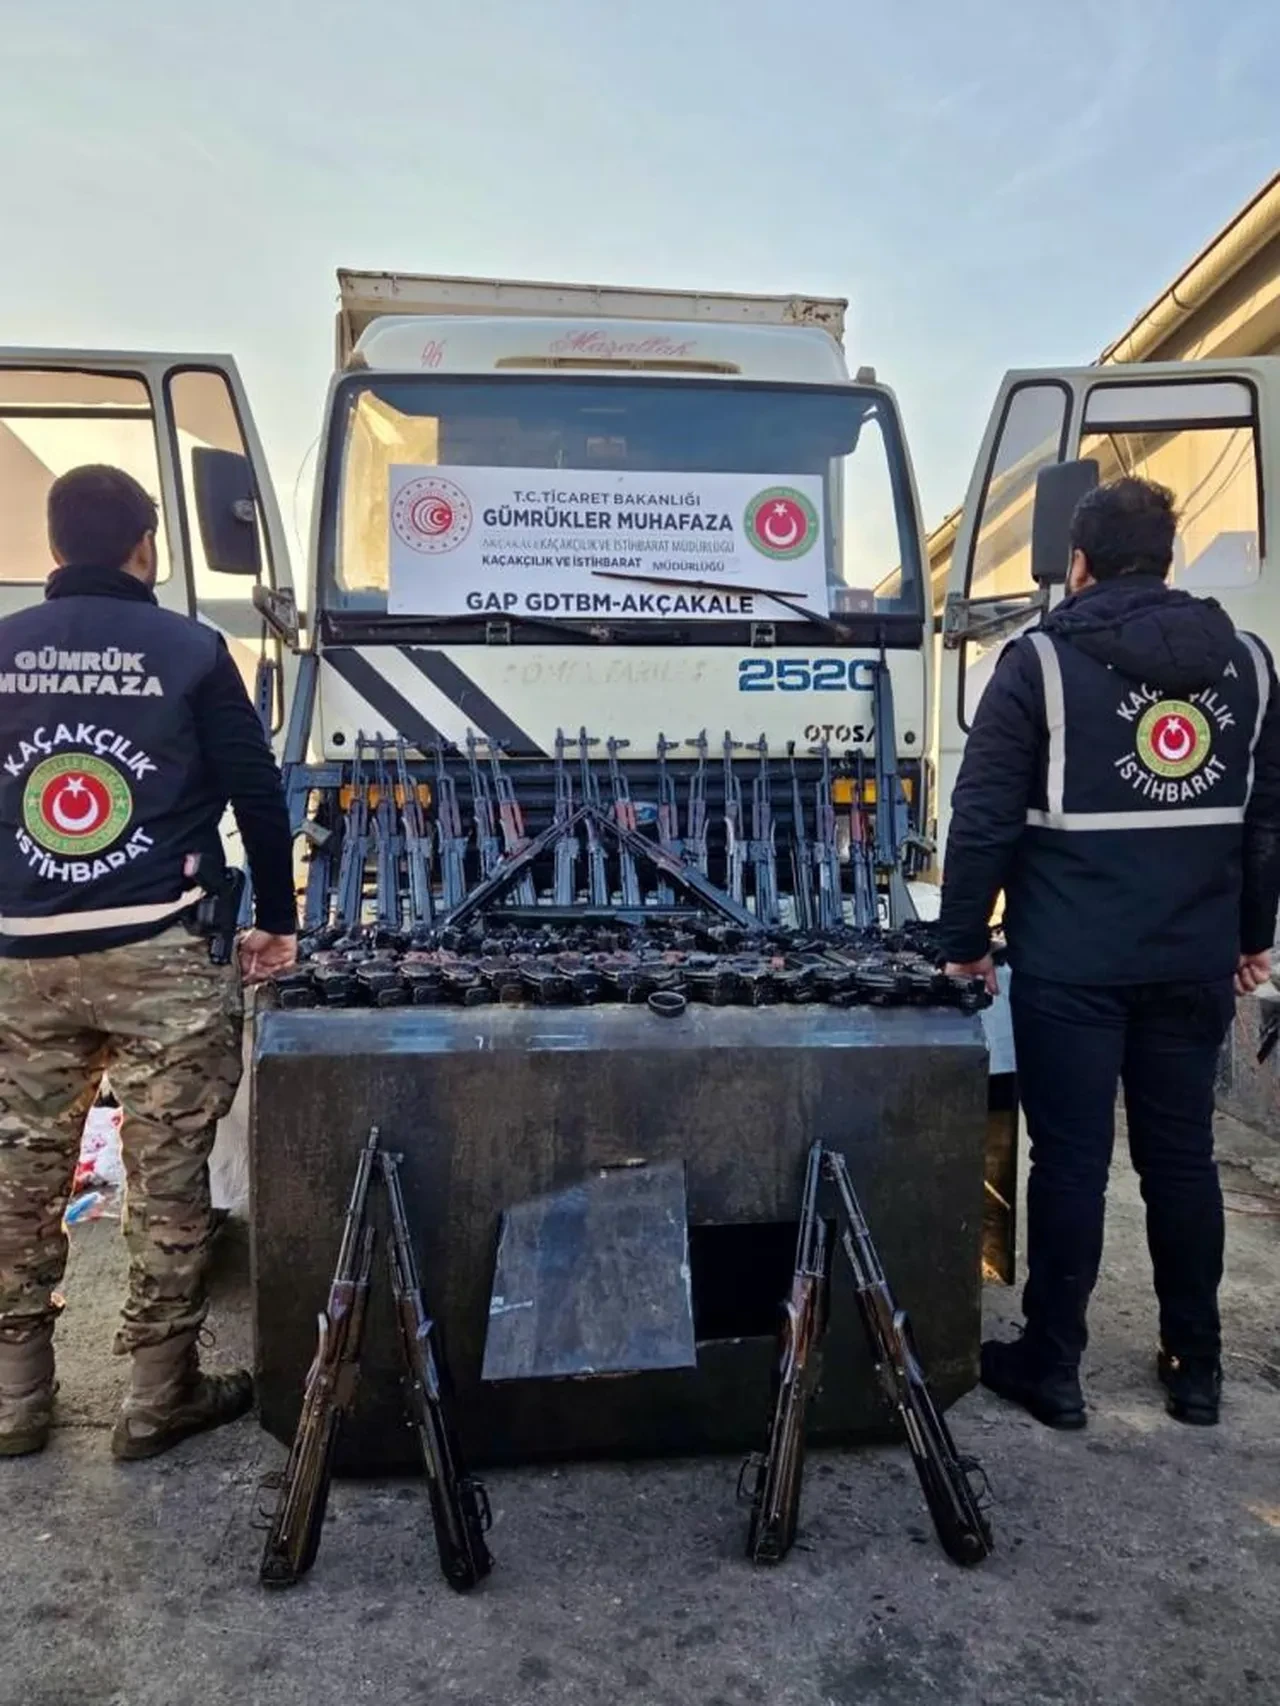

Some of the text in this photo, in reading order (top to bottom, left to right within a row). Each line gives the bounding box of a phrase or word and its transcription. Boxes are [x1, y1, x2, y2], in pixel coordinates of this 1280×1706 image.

[613, 491, 701, 506] BAKANLIĞI
[483, 504, 733, 531] GÜMRÜKLER MUHAFAZA
[482, 554, 553, 567] KAÇAKÇILIK
[555, 556, 571, 567] VE
[572, 555, 642, 568] İSTİHBARAT
[466, 591, 518, 611] GAP
[14, 646, 145, 673] GÜMRÜK
[0, 673, 164, 697] MUHAFAZA
[804, 724, 876, 742] OTOS
[4, 723, 158, 780] KAÇAKÇILIK
[1114, 752, 1227, 802] İSTİHBARAT
[16, 826, 154, 883] İSTİHBARAT
